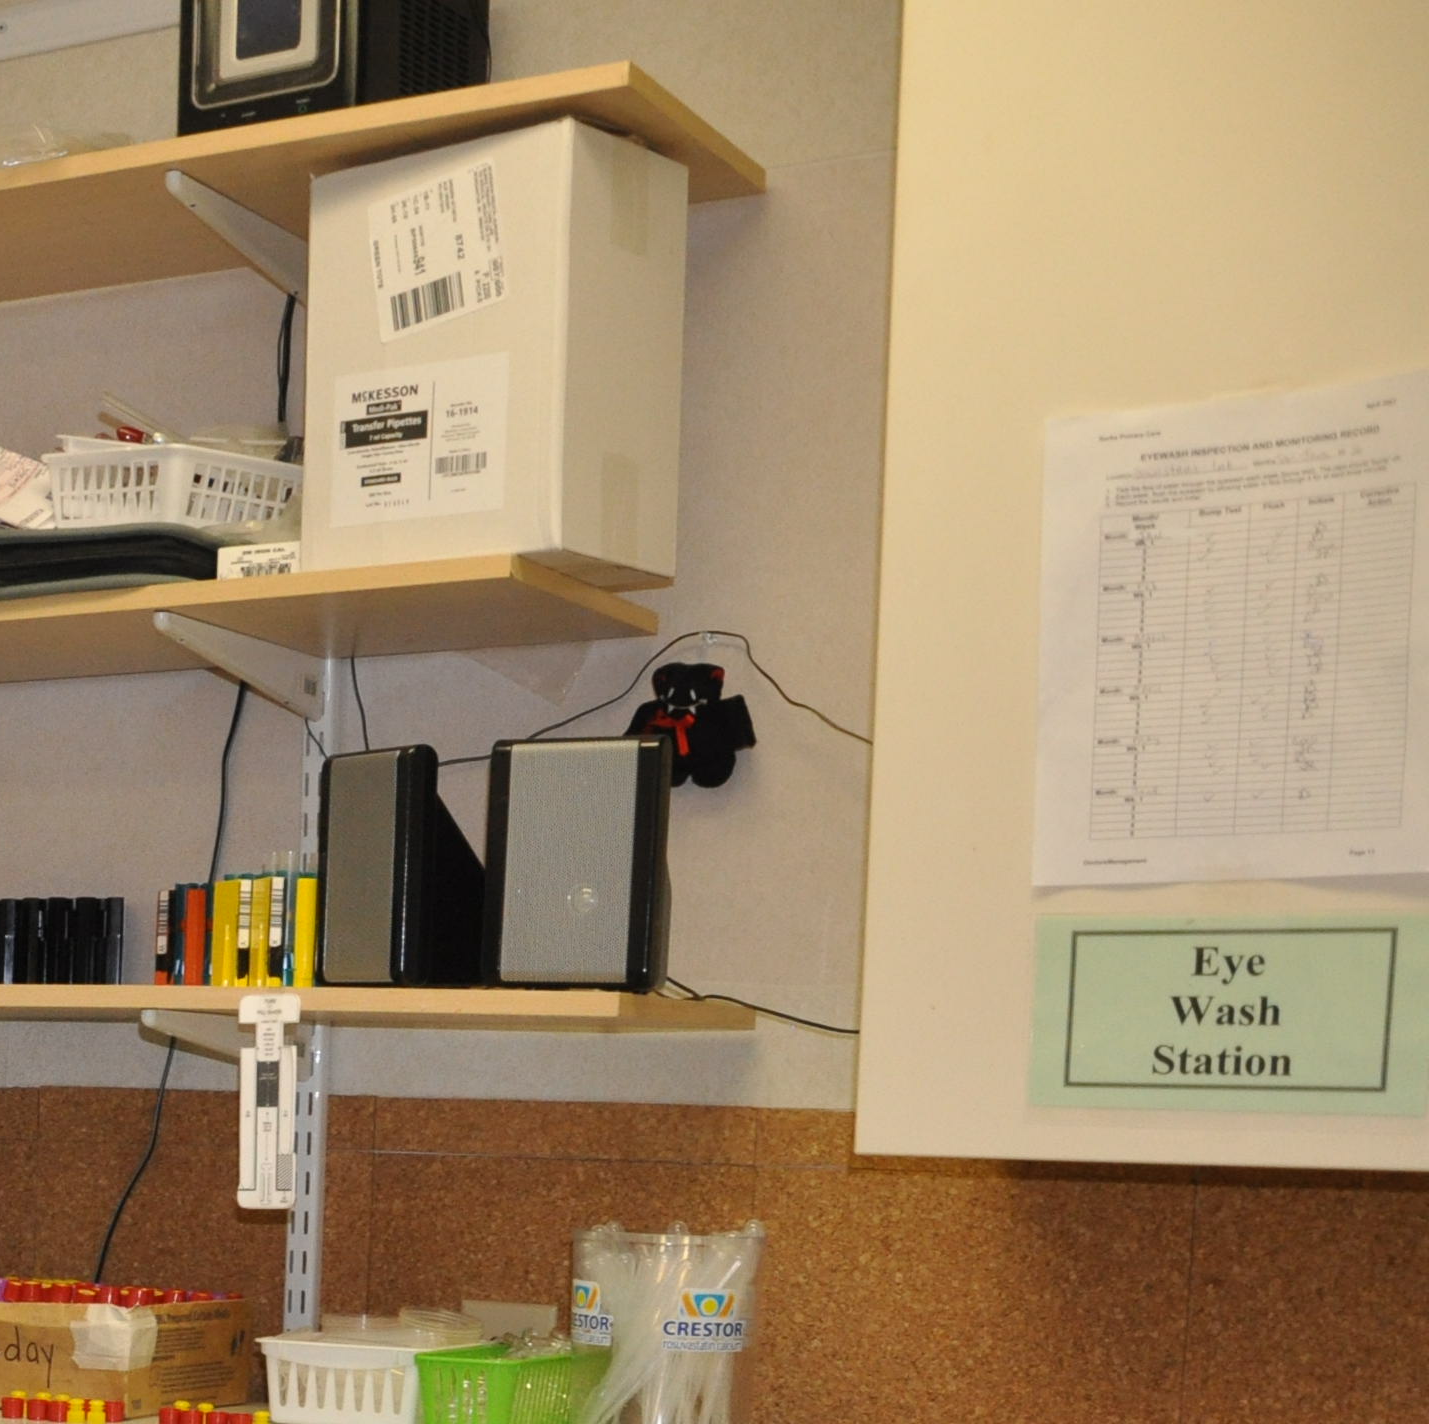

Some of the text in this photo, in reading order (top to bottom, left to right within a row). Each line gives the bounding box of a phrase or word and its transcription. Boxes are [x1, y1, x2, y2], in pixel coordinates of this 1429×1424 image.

[352, 416, 422, 433] Transfer Pipettes
[446, 406, 479, 418] 16-1914
[1141, 424, 1380, 462] EYEWASH INSPECTION AND MONITORING RECORD
[1191, 946, 1266, 985] Eye
[1171, 995, 1281, 1027] Wash
[1152, 1045, 1292, 1077] Station
[663, 1321, 743, 1337] CRESTOR
